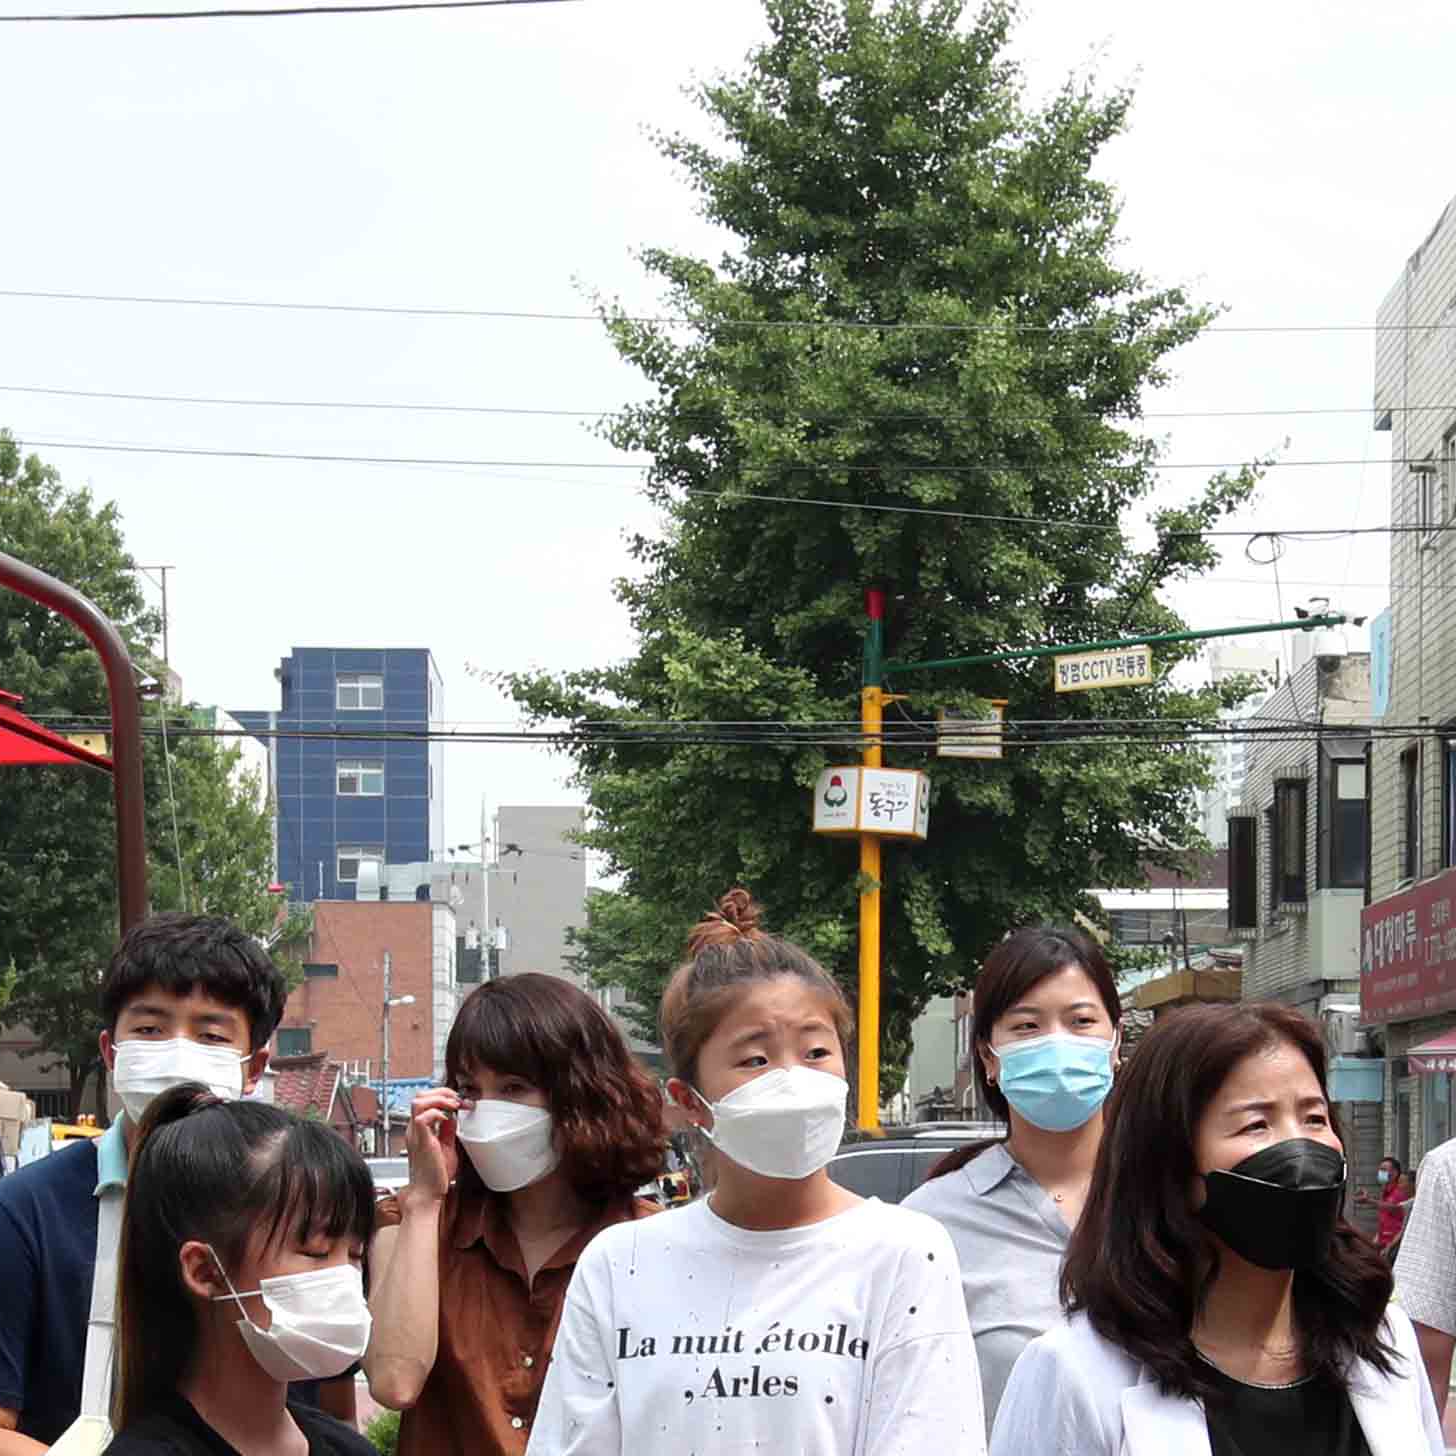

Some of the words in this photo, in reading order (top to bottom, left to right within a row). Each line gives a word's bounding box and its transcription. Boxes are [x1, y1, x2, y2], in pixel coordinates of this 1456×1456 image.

[617, 1328, 656, 1360] La
[671, 1327, 744, 1355] nuit
[701, 1366, 799, 1398] Arles
